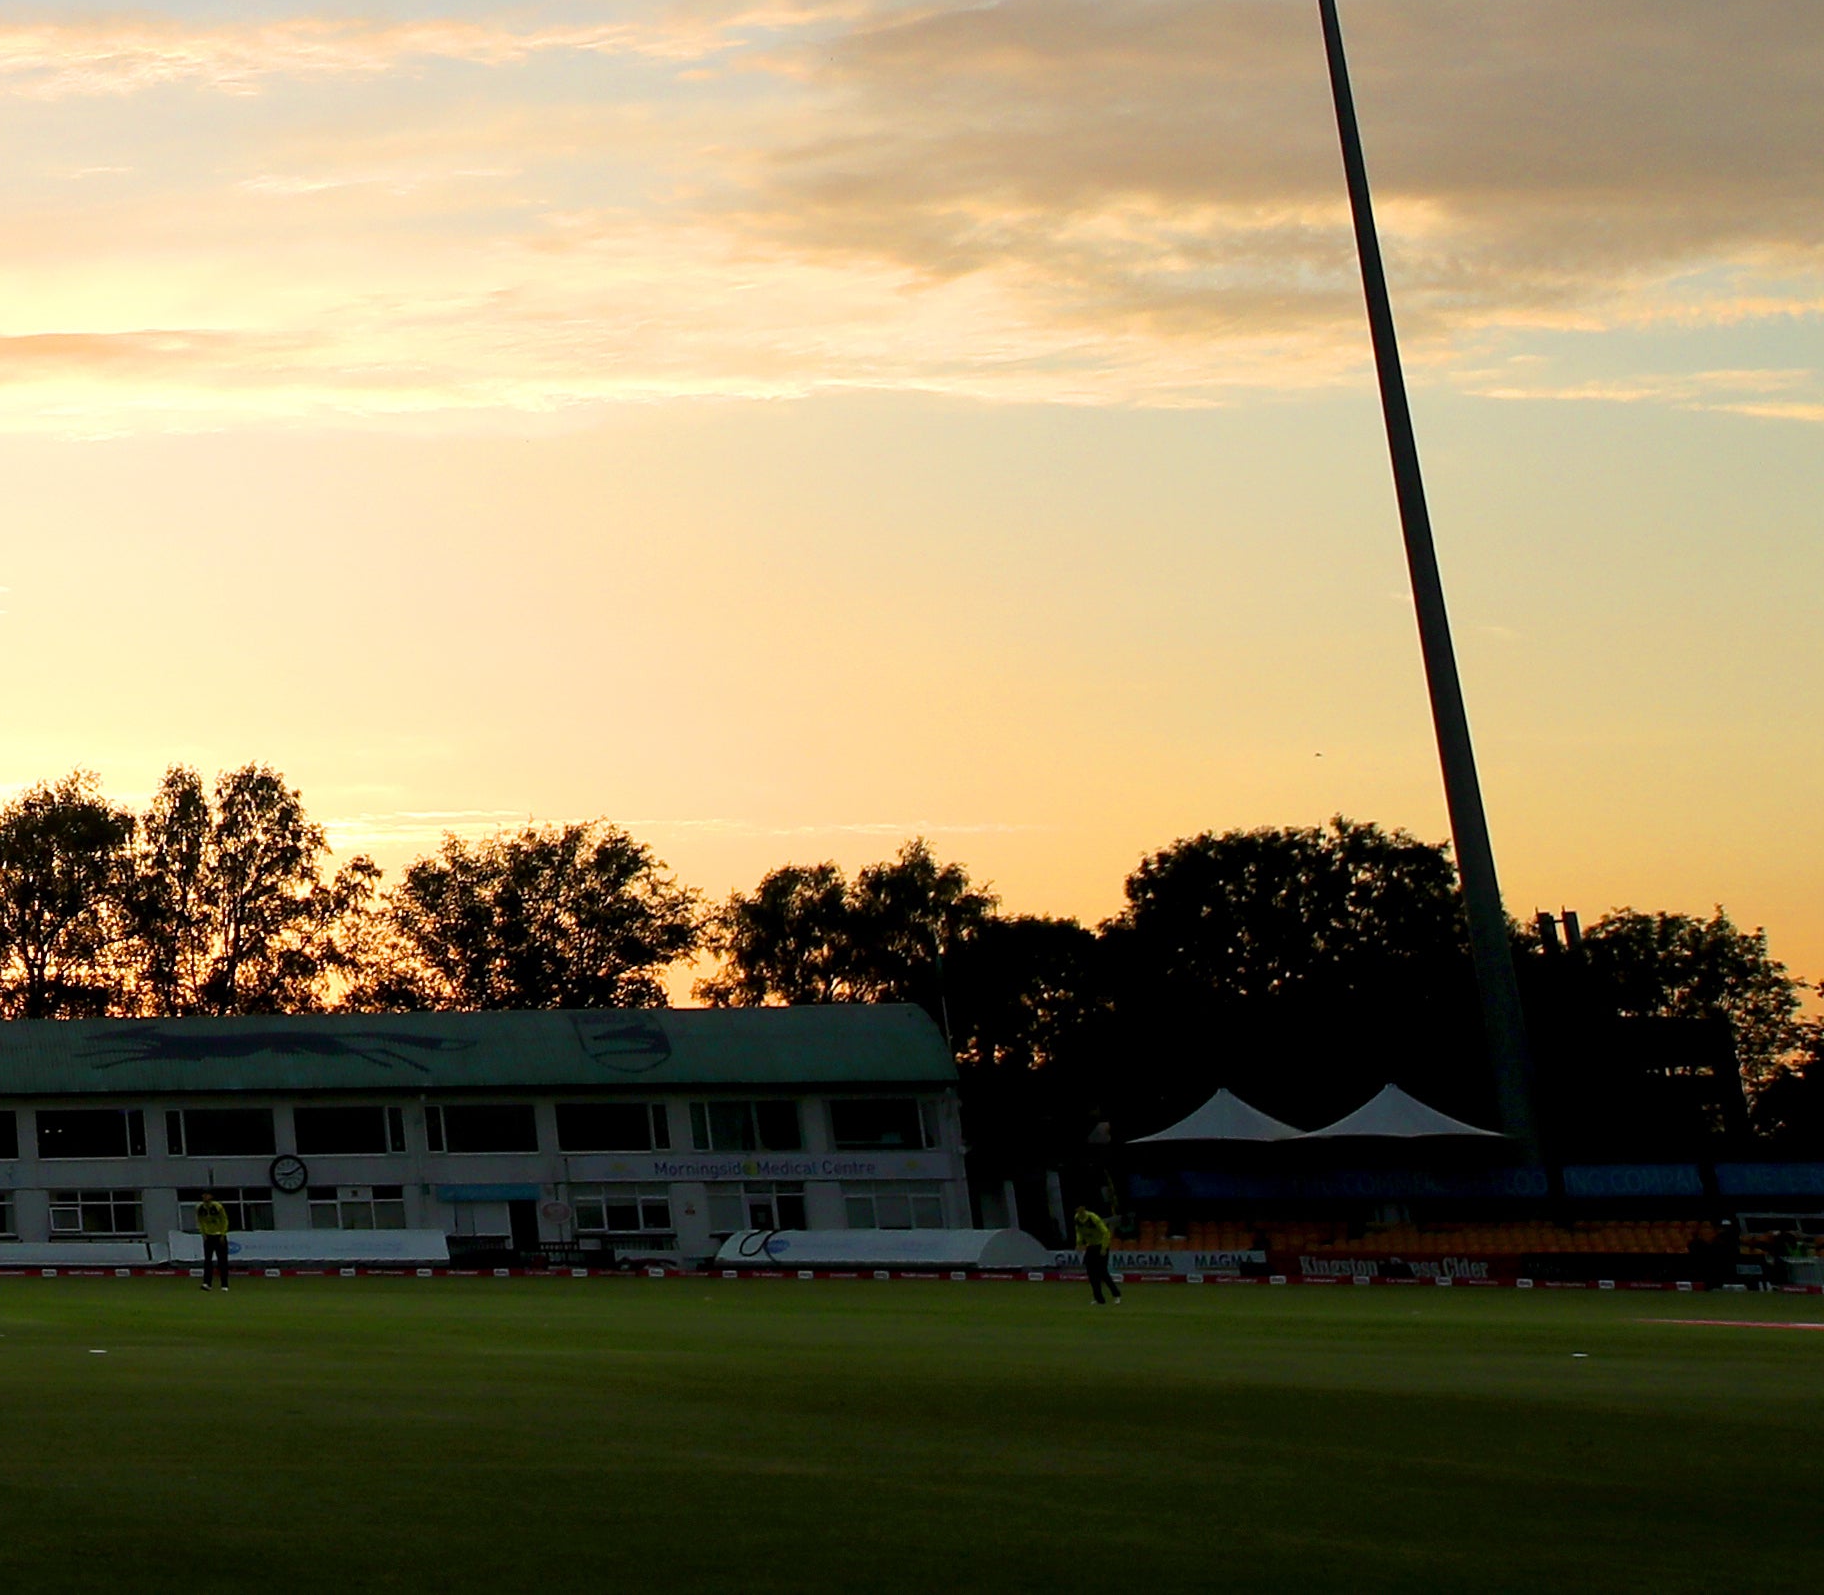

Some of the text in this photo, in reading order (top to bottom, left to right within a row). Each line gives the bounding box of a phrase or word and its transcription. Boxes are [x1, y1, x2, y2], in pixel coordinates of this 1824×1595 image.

[654, 1159, 876, 1179] Morningside Medical Centre
[1112, 1253, 1173, 1268] MAGMA
[1194, 1253, 1254, 1268] MAGMA
[1299, 1256, 1379, 1277] Kingston
[1442, 1256, 1489, 1278] Cider
